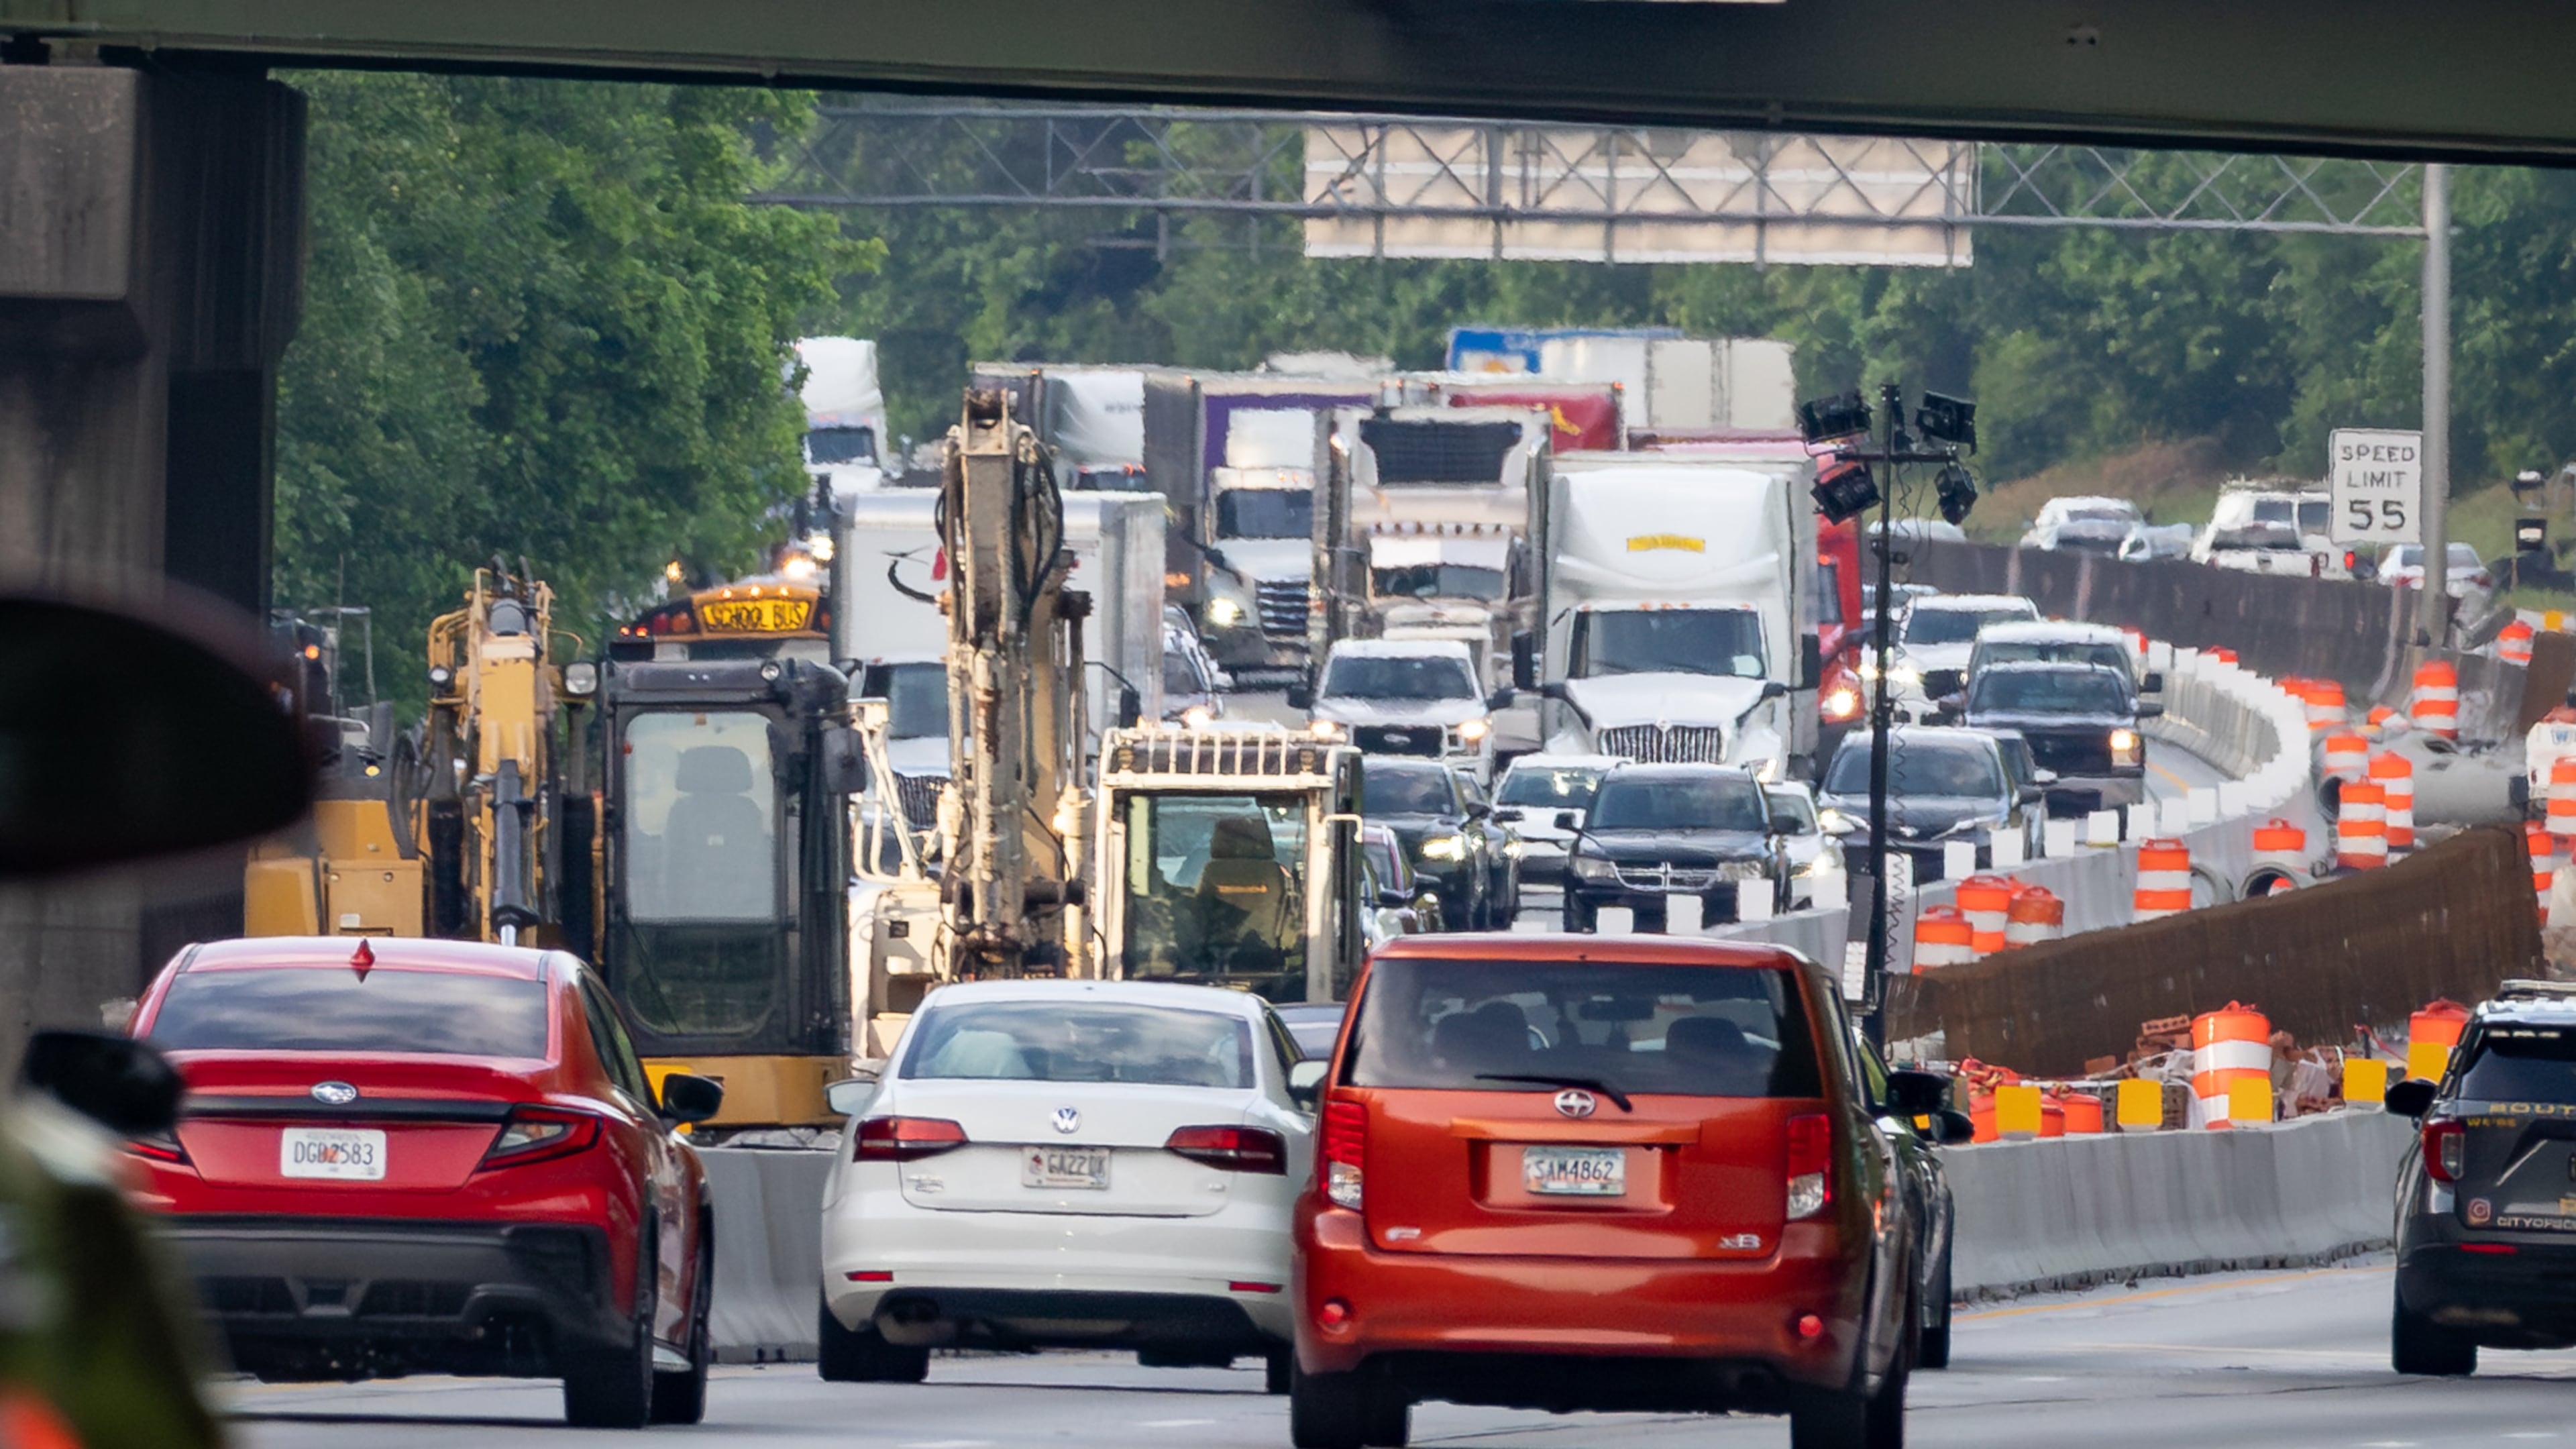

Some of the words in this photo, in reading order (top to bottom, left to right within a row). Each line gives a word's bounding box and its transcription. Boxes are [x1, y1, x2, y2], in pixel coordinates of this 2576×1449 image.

[2341, 443, 2415, 462] SPEED
[2347, 470, 2408, 488] LIMIT
[2349, 499, 2406, 530] 55
[708, 603, 769, 629] SCHOOL
[774, 602, 804, 627] BUS
[1534, 1160, 1615, 1181] SAM4862
